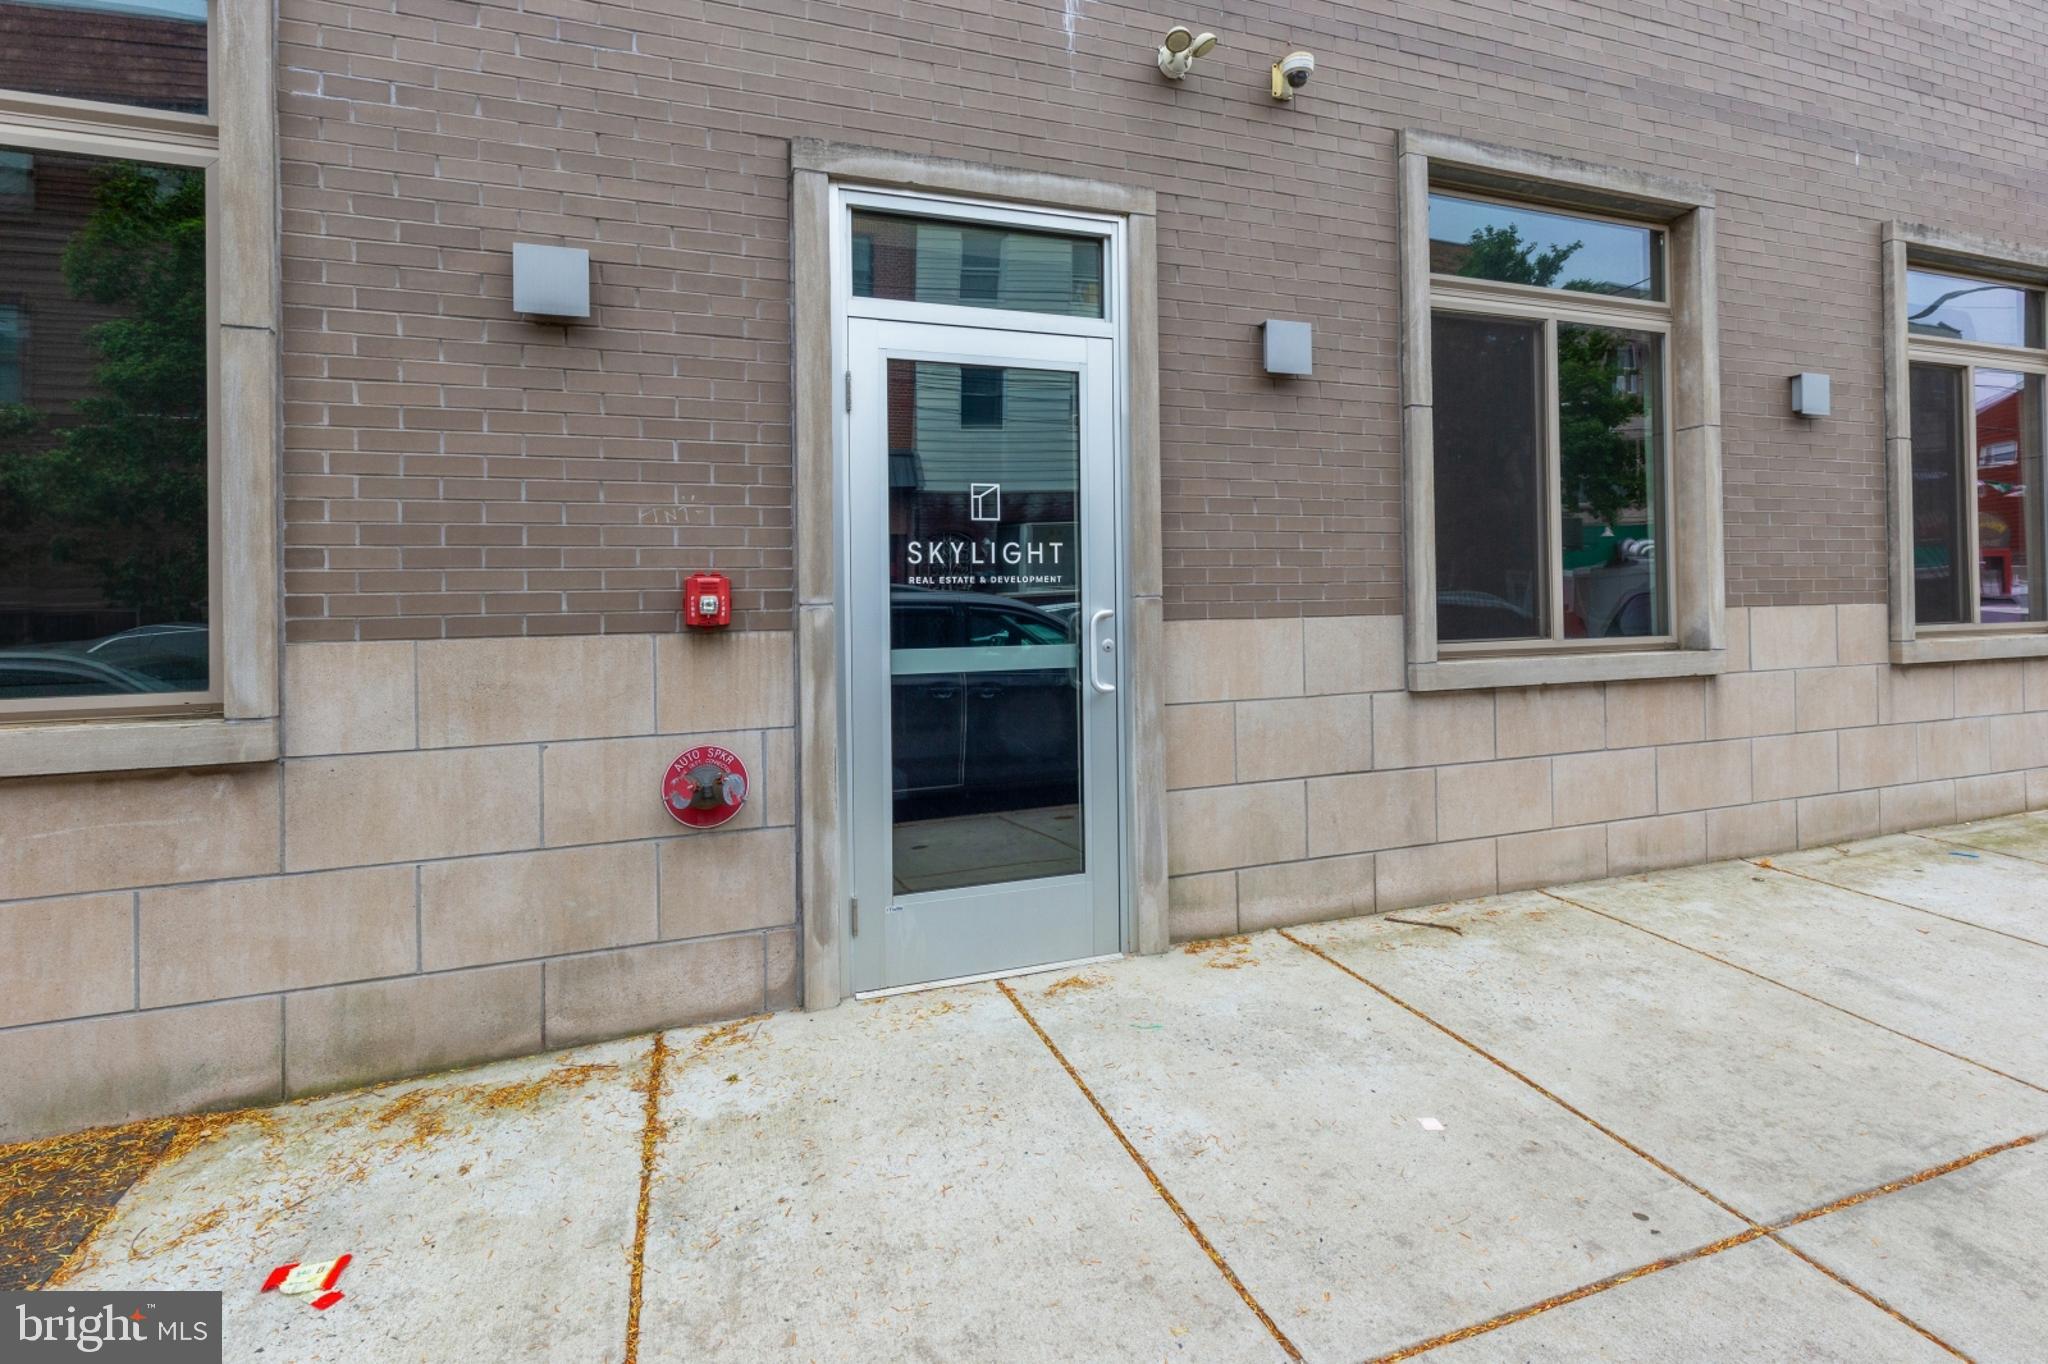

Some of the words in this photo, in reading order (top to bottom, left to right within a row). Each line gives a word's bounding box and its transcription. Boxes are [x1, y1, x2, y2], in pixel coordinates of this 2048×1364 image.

[908, 541, 1063, 565] SKYLIGHT
[908, 576, 935, 585] REAL
[939, 576, 975, 585] ESTATE
[980, 576, 987, 585] &
[990, 575, 1062, 584] DEVELOPMENT
[674, 750, 700, 772] AUTO
[707, 748, 734, 765] SPKR
